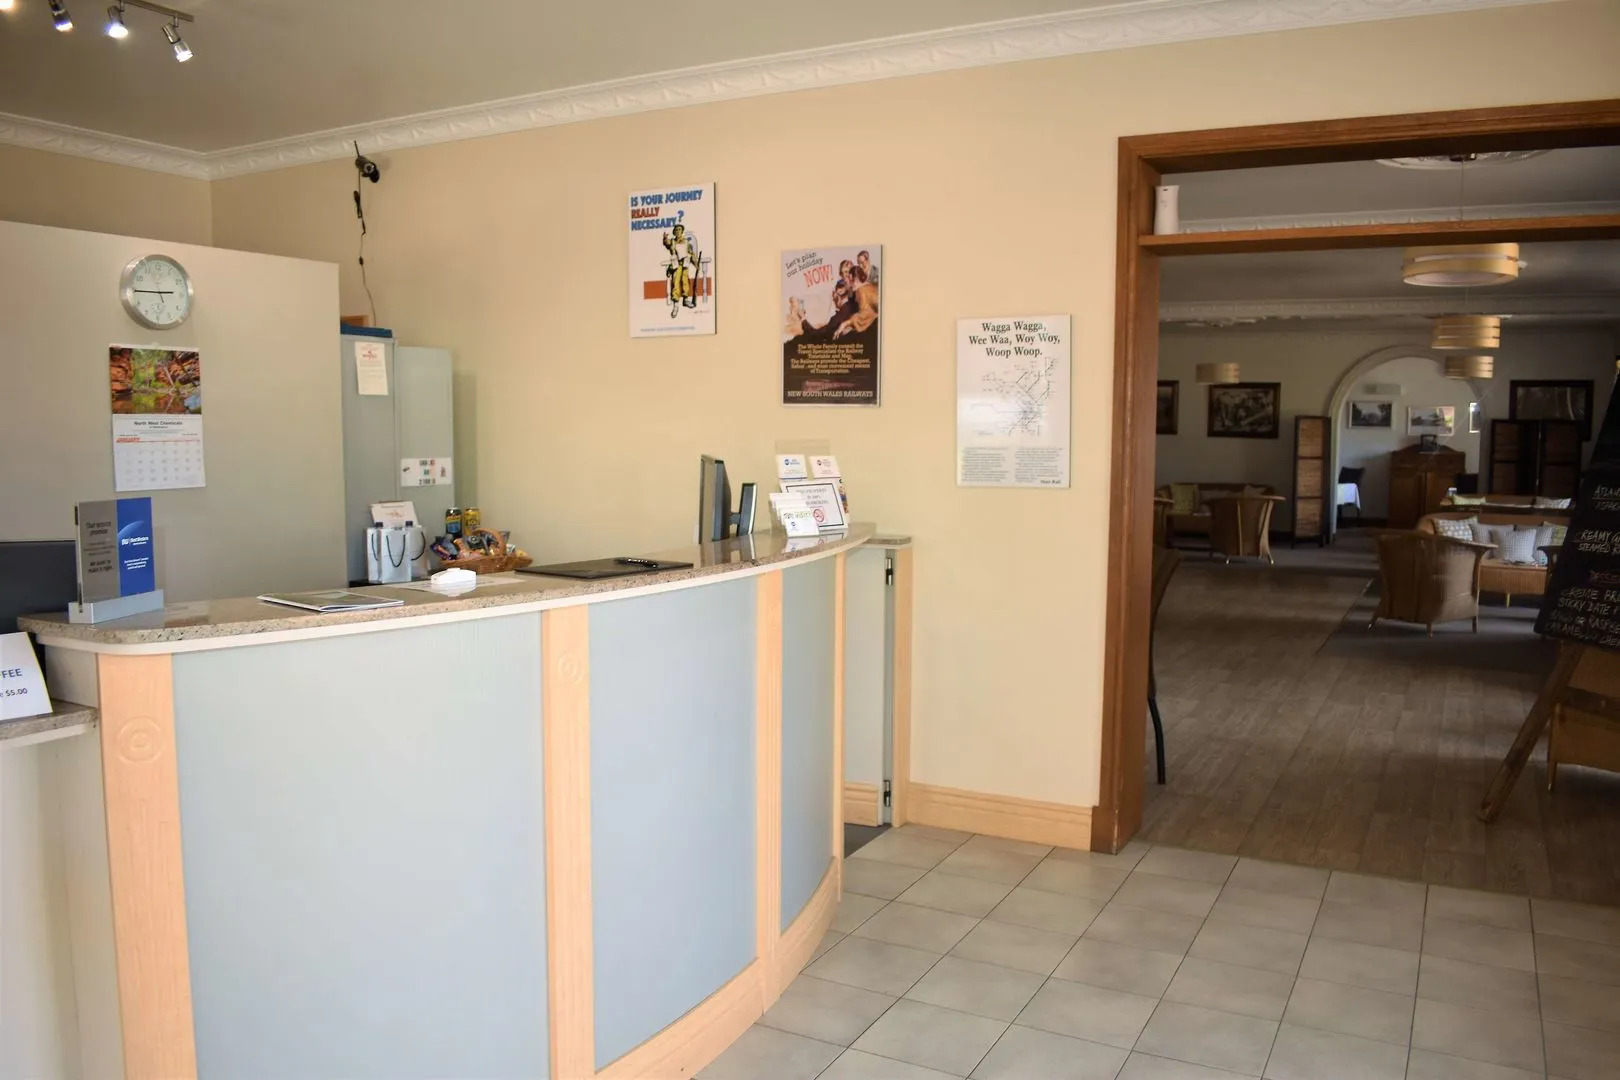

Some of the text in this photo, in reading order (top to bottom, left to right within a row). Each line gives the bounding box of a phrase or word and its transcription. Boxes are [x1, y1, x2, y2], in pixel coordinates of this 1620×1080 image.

[631, 190, 703, 207] IS YOUR JOURNEY
[631, 207, 660, 218] REALLY
[802, 252, 816, 262] plan
[804, 264, 833, 287] NOW!
[982, 321, 1046, 334] Wagga Wagga,
[968, 333, 1060, 345] Wee Waa, Woy Woy,
[986, 346, 1043, 358] Woop Woop.
[0, 668, 23, 679] FEE
